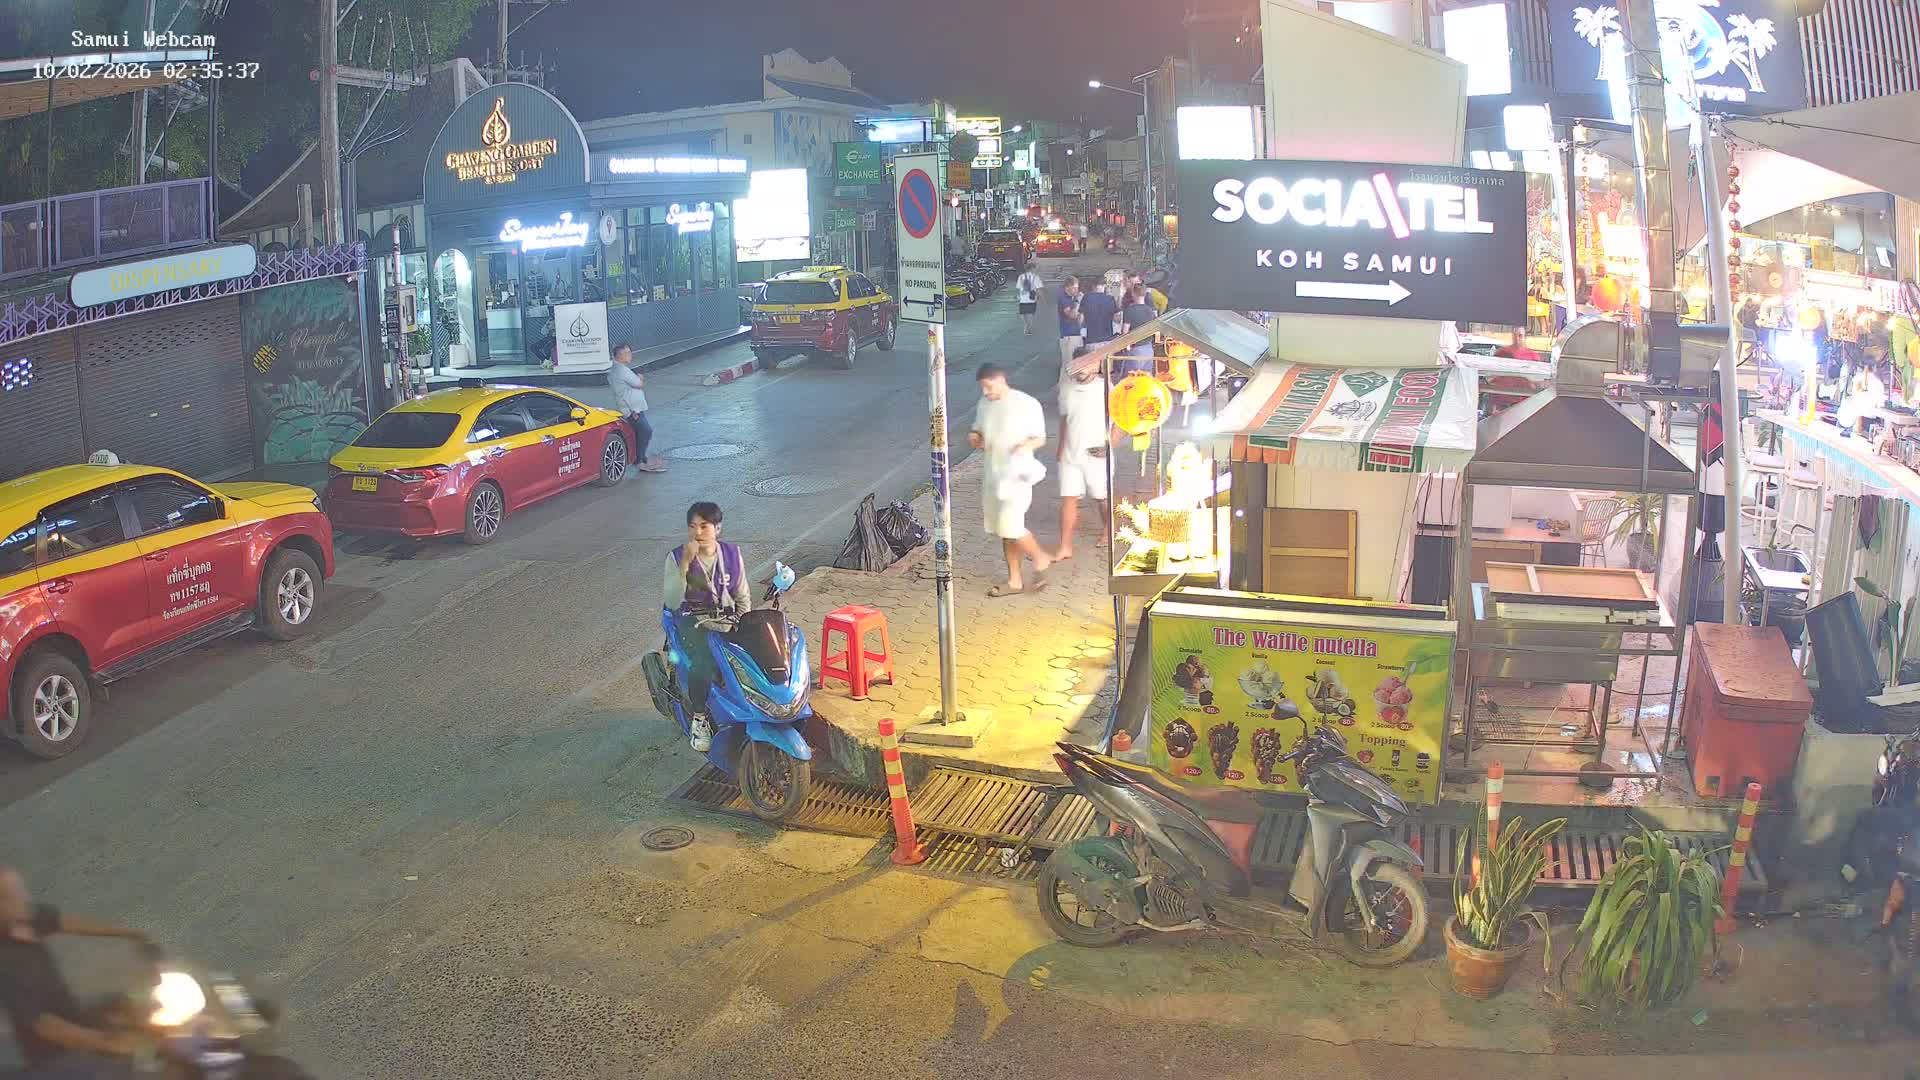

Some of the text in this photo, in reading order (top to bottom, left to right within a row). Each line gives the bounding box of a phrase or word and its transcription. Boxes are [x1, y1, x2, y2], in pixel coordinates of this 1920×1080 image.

[838, 169, 879, 180] EXCHANGE
[1256, 249, 1452, 276] KOH SAMUI
[110, 255, 223, 293] DISPENSARY
[904, 280, 937, 289] NO PARKING
[1212, 627, 1378, 658] The Waffle nutella
[1376, 663, 1405, 672] Strawberry
[1359, 733, 1407, 747] Topping
